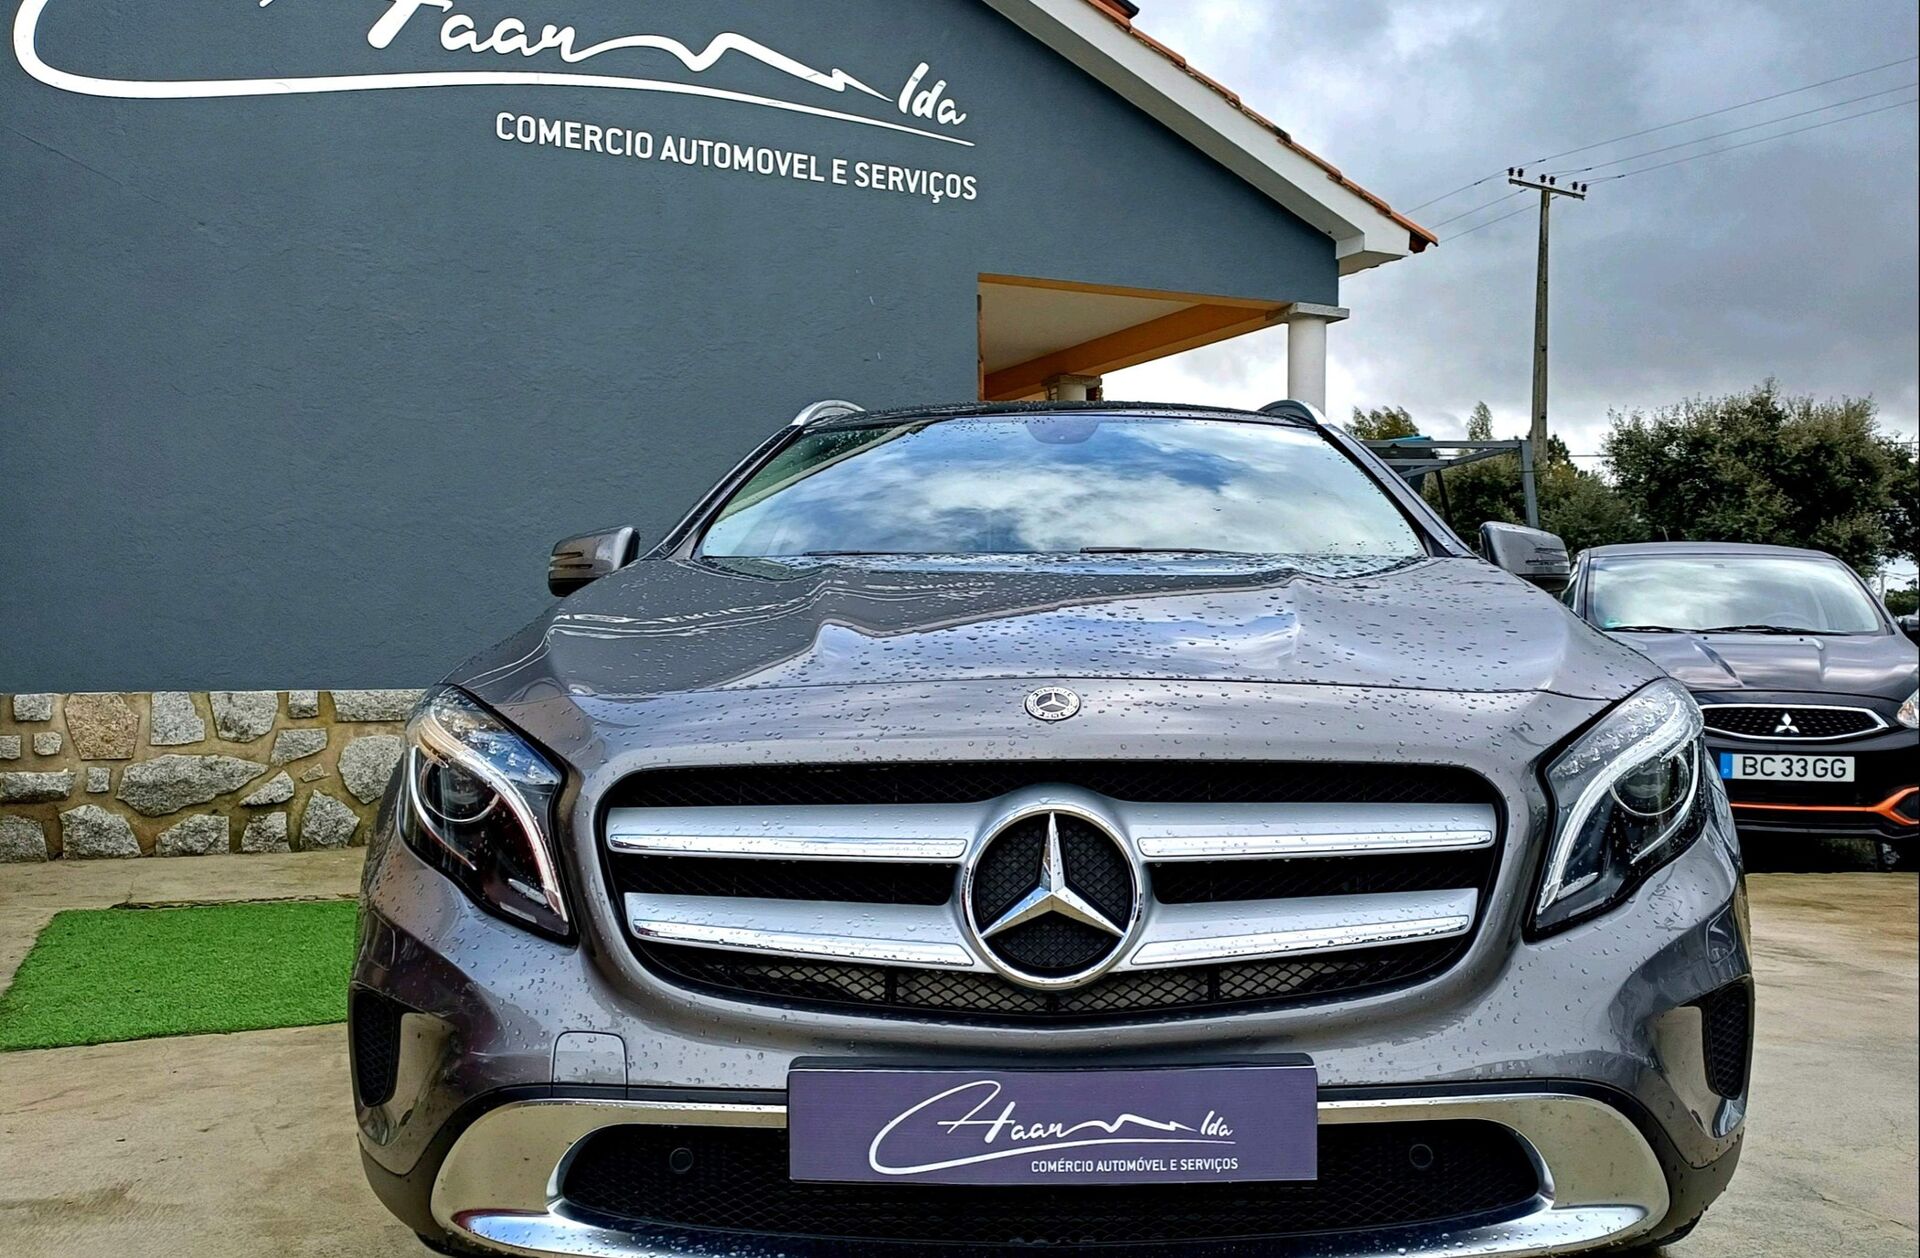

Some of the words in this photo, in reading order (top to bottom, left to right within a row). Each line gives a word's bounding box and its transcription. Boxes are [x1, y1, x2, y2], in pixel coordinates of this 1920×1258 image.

[496, 111, 653, 160] COMERCIO
[660, 135, 825, 182] AUTOMOVEL
[832, 158, 848, 185] E
[854, 161, 978, 204] SERVIÇOS
[1031, 1157, 1094, 1172] COMÉRCIO
[1096, 1156, 1168, 1172] AUTOMÓVEL
[1170, 1157, 1178, 1171] E
[1180, 1157, 1239, 1174] SERVIÇOS
